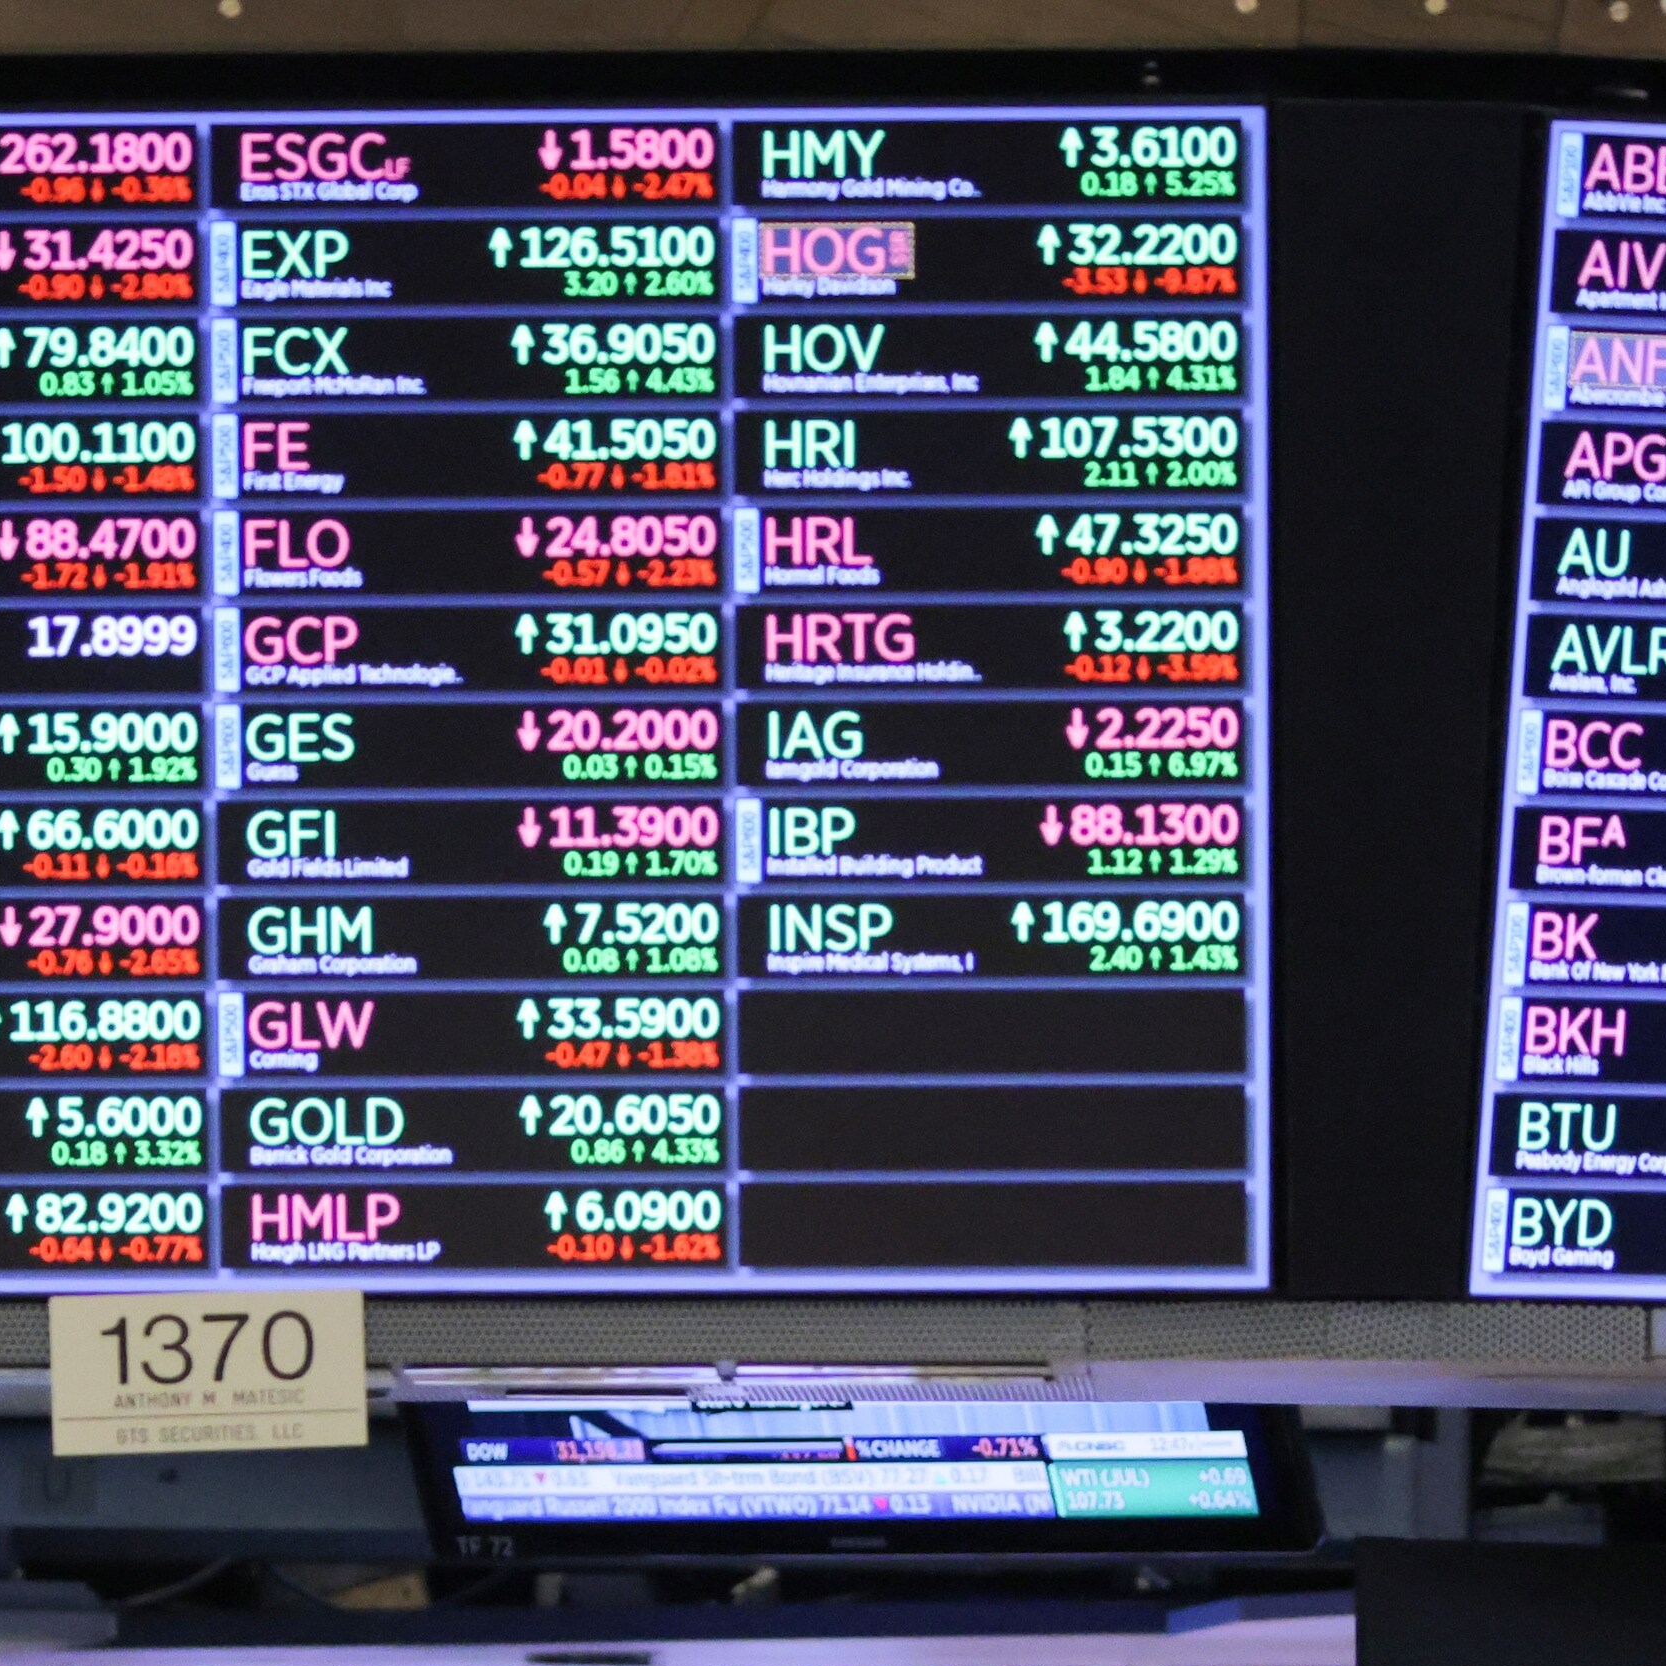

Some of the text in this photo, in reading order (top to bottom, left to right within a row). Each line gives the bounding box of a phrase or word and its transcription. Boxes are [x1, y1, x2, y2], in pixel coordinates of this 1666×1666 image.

[762, 129, 886, 179] HMY
[241, 229, 350, 278] EXP
[763, 228, 884, 274] HOG
[1067, 223, 1238, 263] 32.2200
[242, 326, 350, 375] FCX
[763, 323, 886, 372] HOV
[242, 421, 311, 471] FE
[764, 419, 856, 469] HRI
[1040, 415, 1238, 456] 107.5300
[243, 518, 351, 568] FLO
[765, 515, 874, 565] HRL
[244, 615, 359, 664] GCP
[767, 612, 916, 662] HRTG
[245, 712, 356, 761] GES
[768, 710, 864, 759] IAG
[1095, 706, 1240, 746] 2.2250
[247, 809, 337, 857] GFI
[770, 806, 856, 855] IBP
[248, 905, 373, 954] GHM
[771, 902, 894, 952] INSP
[1043, 900, 1240, 940] 169.6900
[250, 1000, 375, 1050] GLW
[252, 1096, 405, 1147] GOLD
[253, 1192, 401, 1243] HMLP
[1507, 1197, 1613, 1248] BYD
[100, 1310, 314, 1385] 1370
[466, 1442, 509, 1461] DOW
